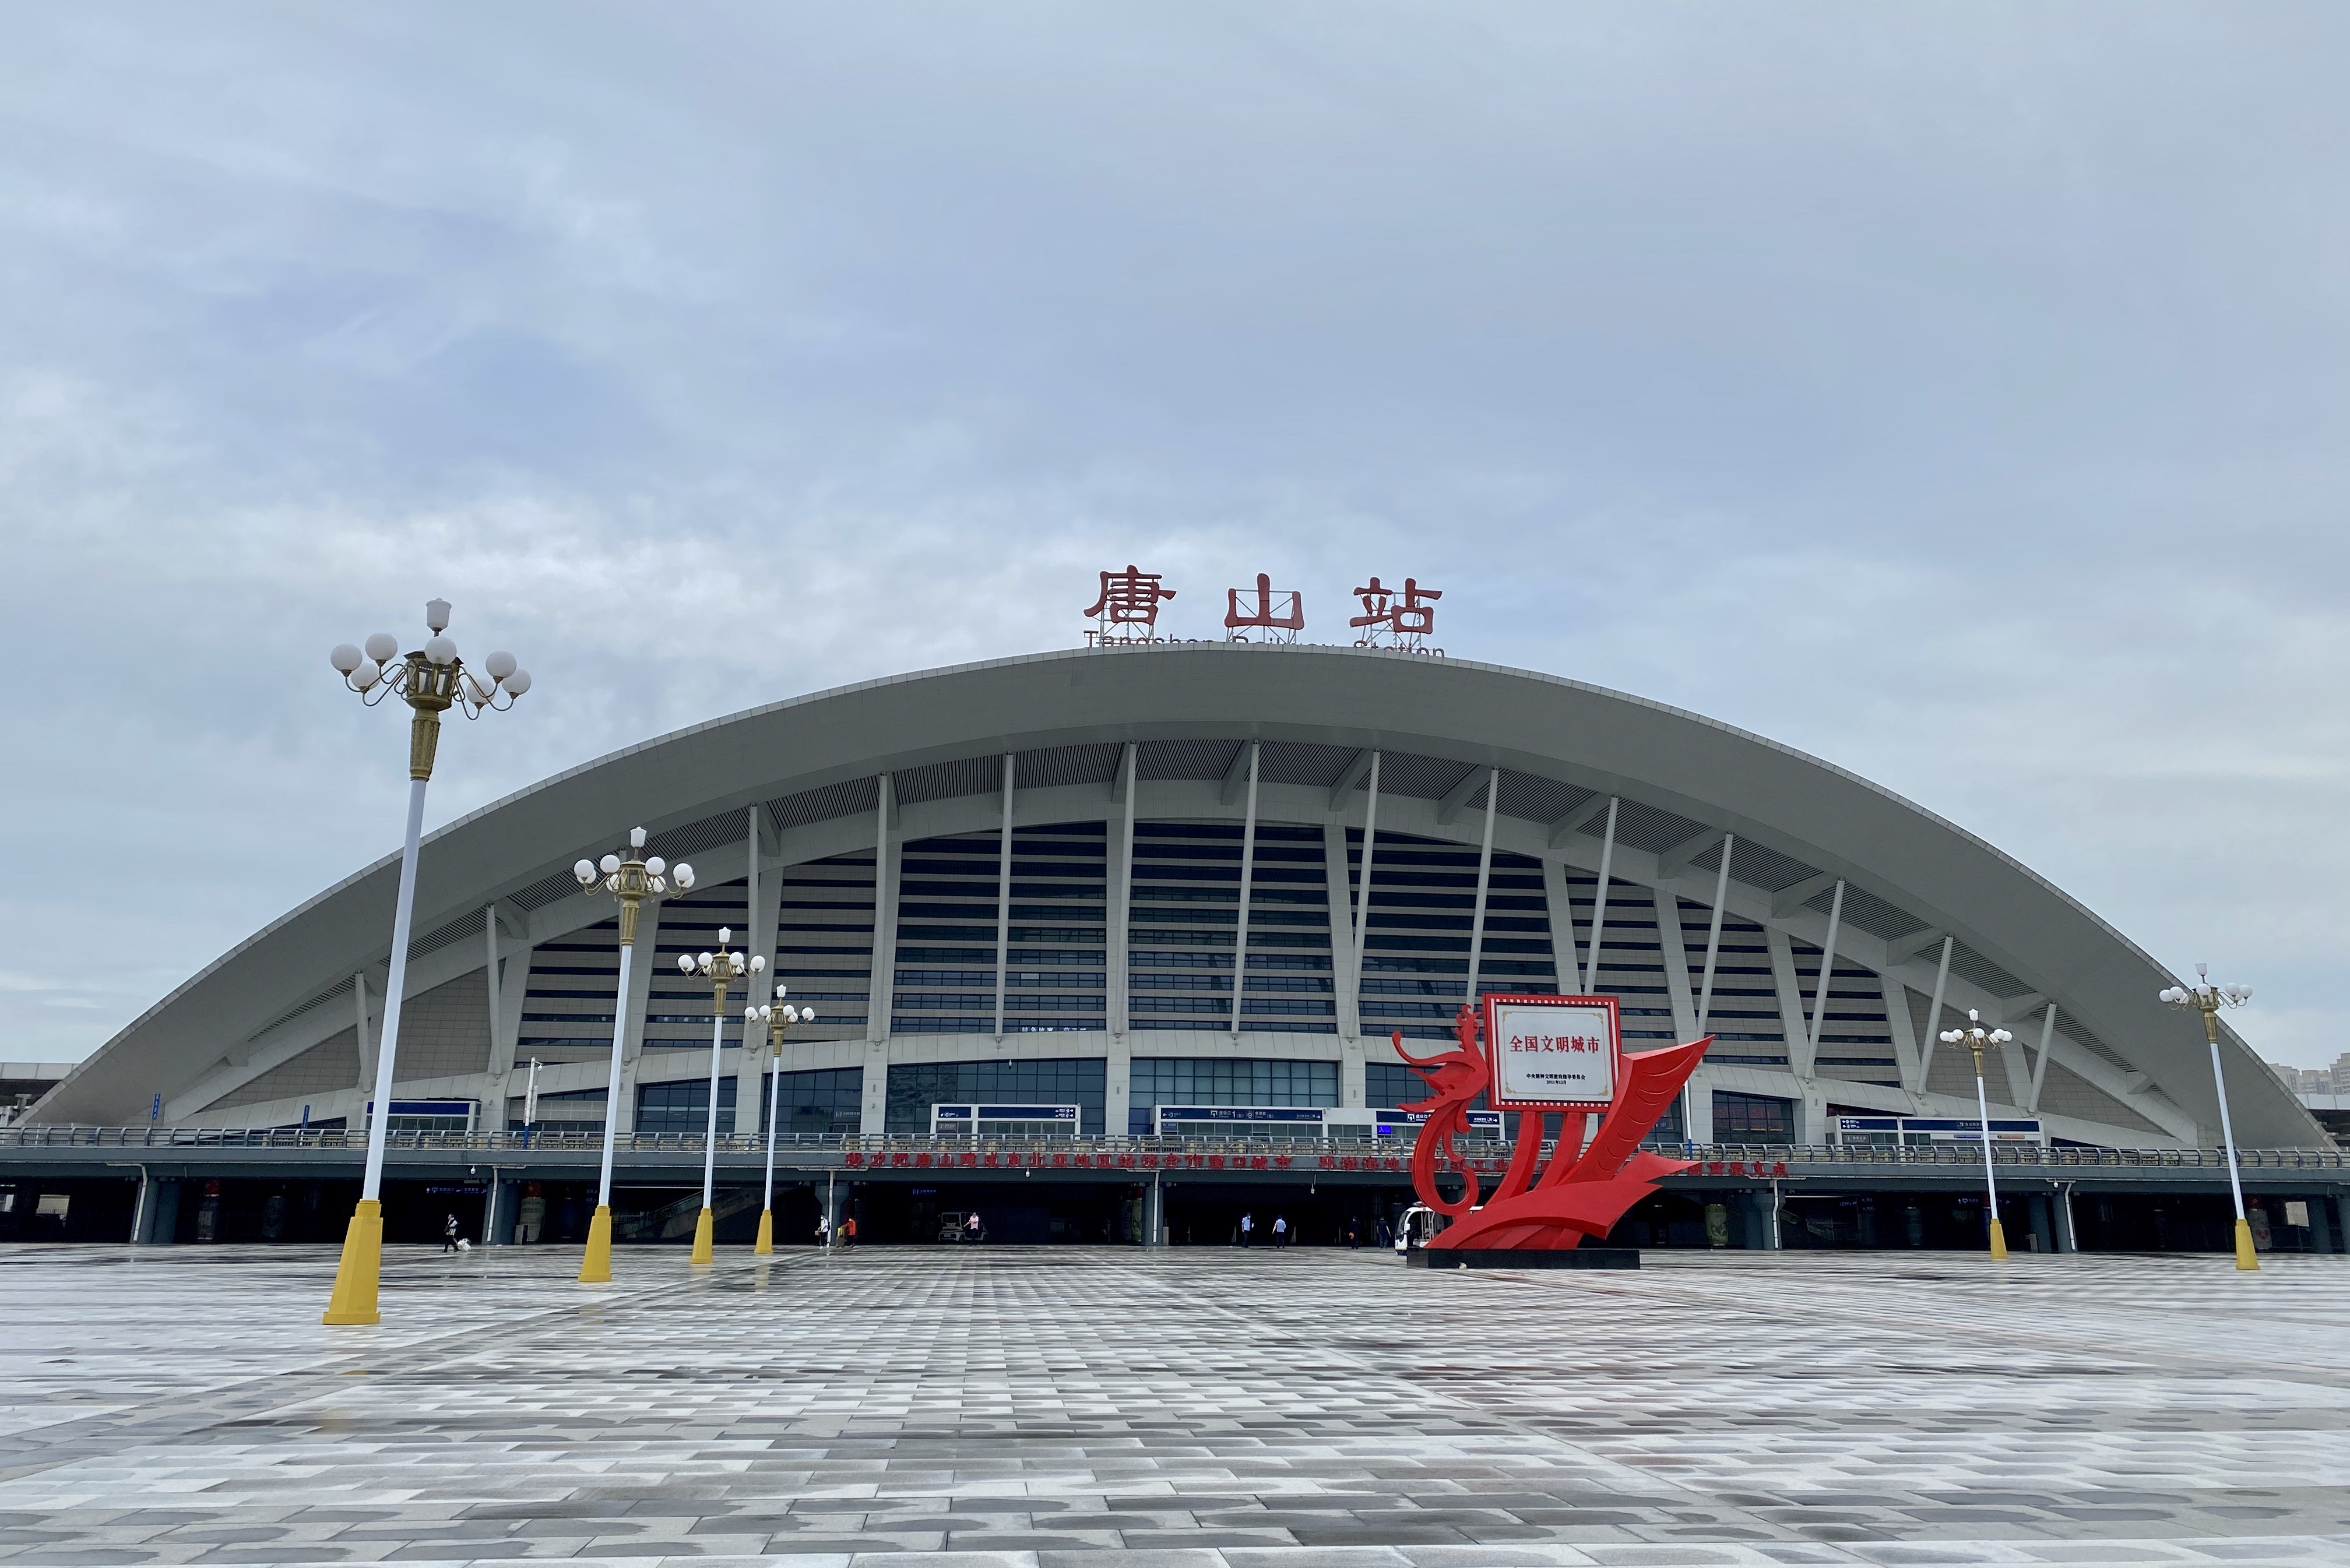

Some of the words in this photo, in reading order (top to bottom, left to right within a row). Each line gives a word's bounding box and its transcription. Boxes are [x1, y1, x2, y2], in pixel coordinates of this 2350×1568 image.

[1083, 565, 1443, 634] 唐山站
[1510, 1035, 1600, 1053] 全国文明城市
